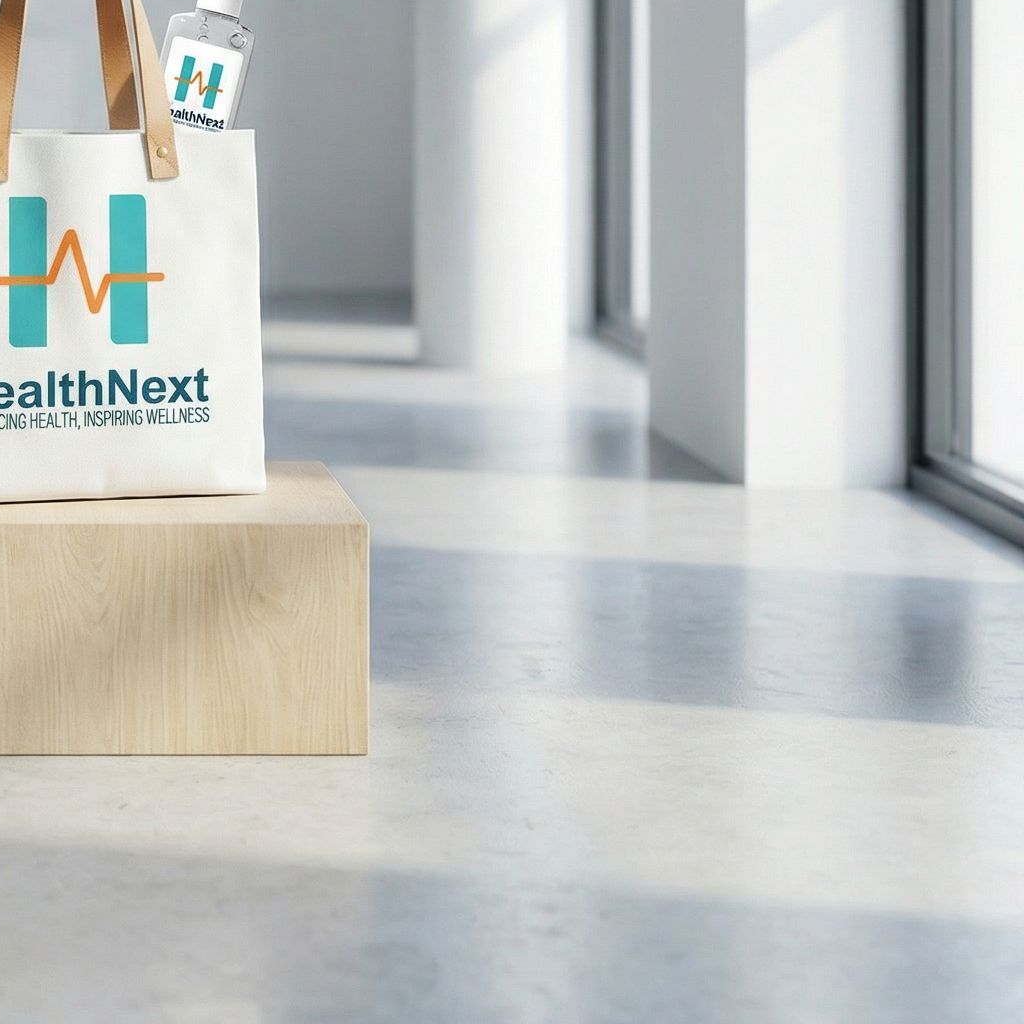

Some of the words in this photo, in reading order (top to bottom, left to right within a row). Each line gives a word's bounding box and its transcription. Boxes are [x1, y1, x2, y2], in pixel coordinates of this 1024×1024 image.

[170, 108, 224, 130] althNext
[29, 410, 81, 431] HEALTH,
[83, 408, 143, 428] INSPIRING
[146, 406, 210, 425] WELLNESS
